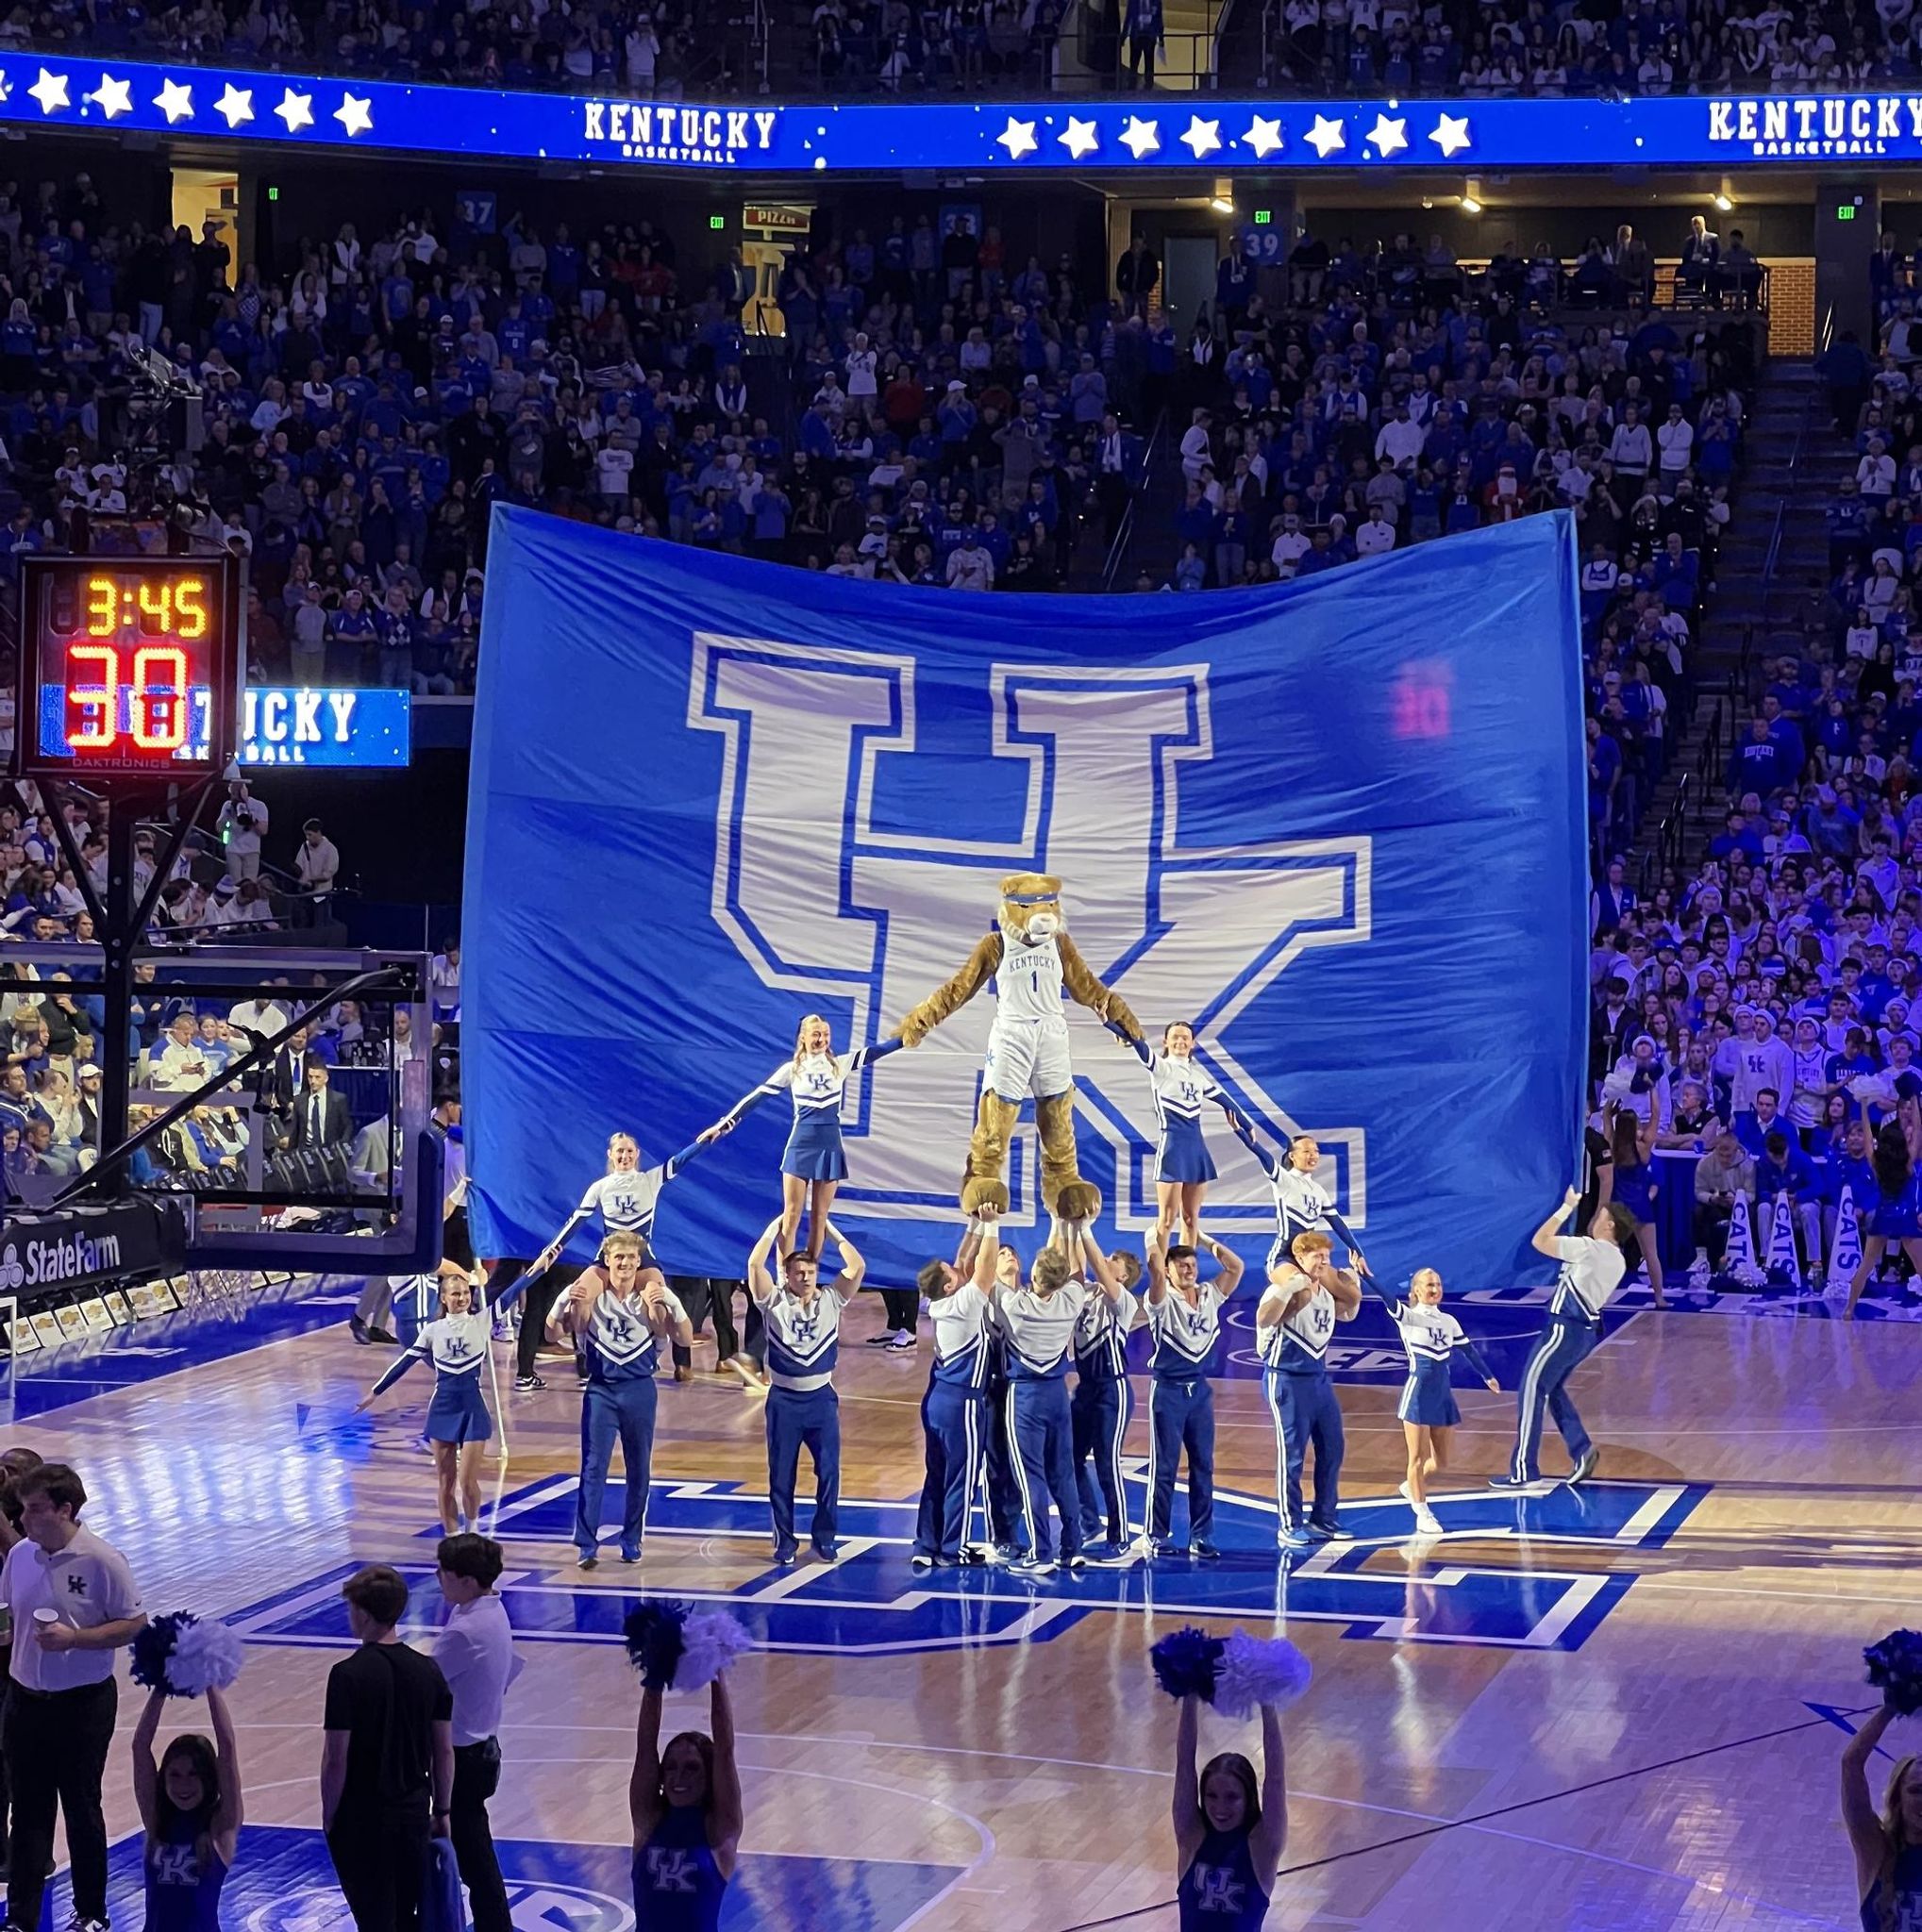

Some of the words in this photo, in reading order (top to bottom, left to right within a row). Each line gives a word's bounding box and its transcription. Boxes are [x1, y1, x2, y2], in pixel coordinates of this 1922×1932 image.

[584, 102, 776, 149] KENTUCKY
[1709, 98, 1922, 141] KENTUCKY
[622, 144, 736, 163] BASKETBALL
[1753, 140, 1886, 156] BASKETBALL
[1255, 210, 1271, 224] EXIT
[1838, 206, 1855, 219] EXIT
[1245, 233, 1279, 257] 39
[89, 579, 207, 638] 3:45
[67, 645, 187, 748] 30
[73, 758, 170, 769] DAKTRONICS
[1009, 956, 1056, 973] KENTUCKY
[1031, 970, 1038, 992] 1
[807, 1073, 832, 1091] UK
[1180, 1081, 1199, 1102] UK
[613, 1194, 641, 1215] UK
[1302, 1194, 1319, 1216] UK
[1771, 1202, 1797, 1274] CATS
[1836, 1197, 1864, 1271] CATS
[605, 1318, 635, 1342] UK
[1312, 1309, 1330, 1333] UK
[446, 1337, 473, 1357] UK
[1428, 1326, 1447, 1346] UK
[68, 1574, 88, 1596] UK
[154, 1842, 200, 1887] UK
[645, 1846, 698, 1892] UK
[1194, 1861, 1245, 1915] UK
